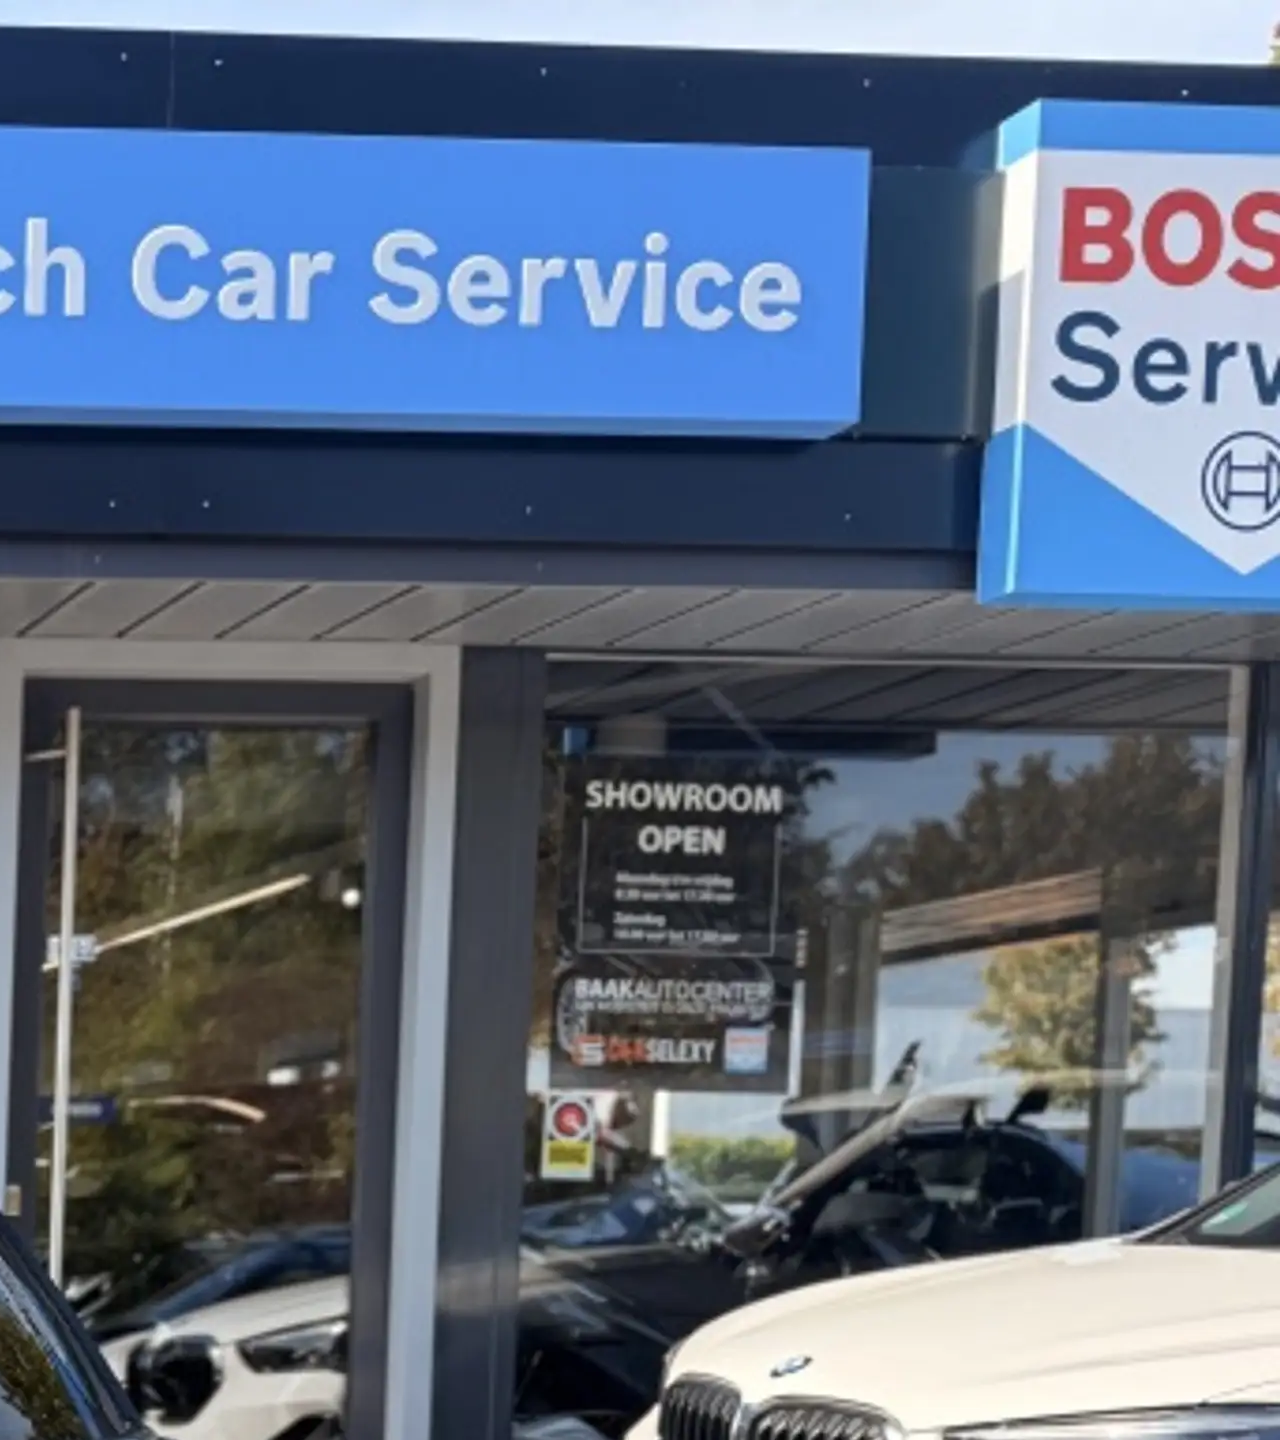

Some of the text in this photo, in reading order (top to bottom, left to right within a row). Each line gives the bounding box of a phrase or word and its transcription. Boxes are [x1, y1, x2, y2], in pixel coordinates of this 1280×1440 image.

[130, 223, 335, 322] Car
[367, 229, 803, 333] Service
[586, 780, 783, 814] SHOWROOM
[638, 824, 726, 855] OPEN
